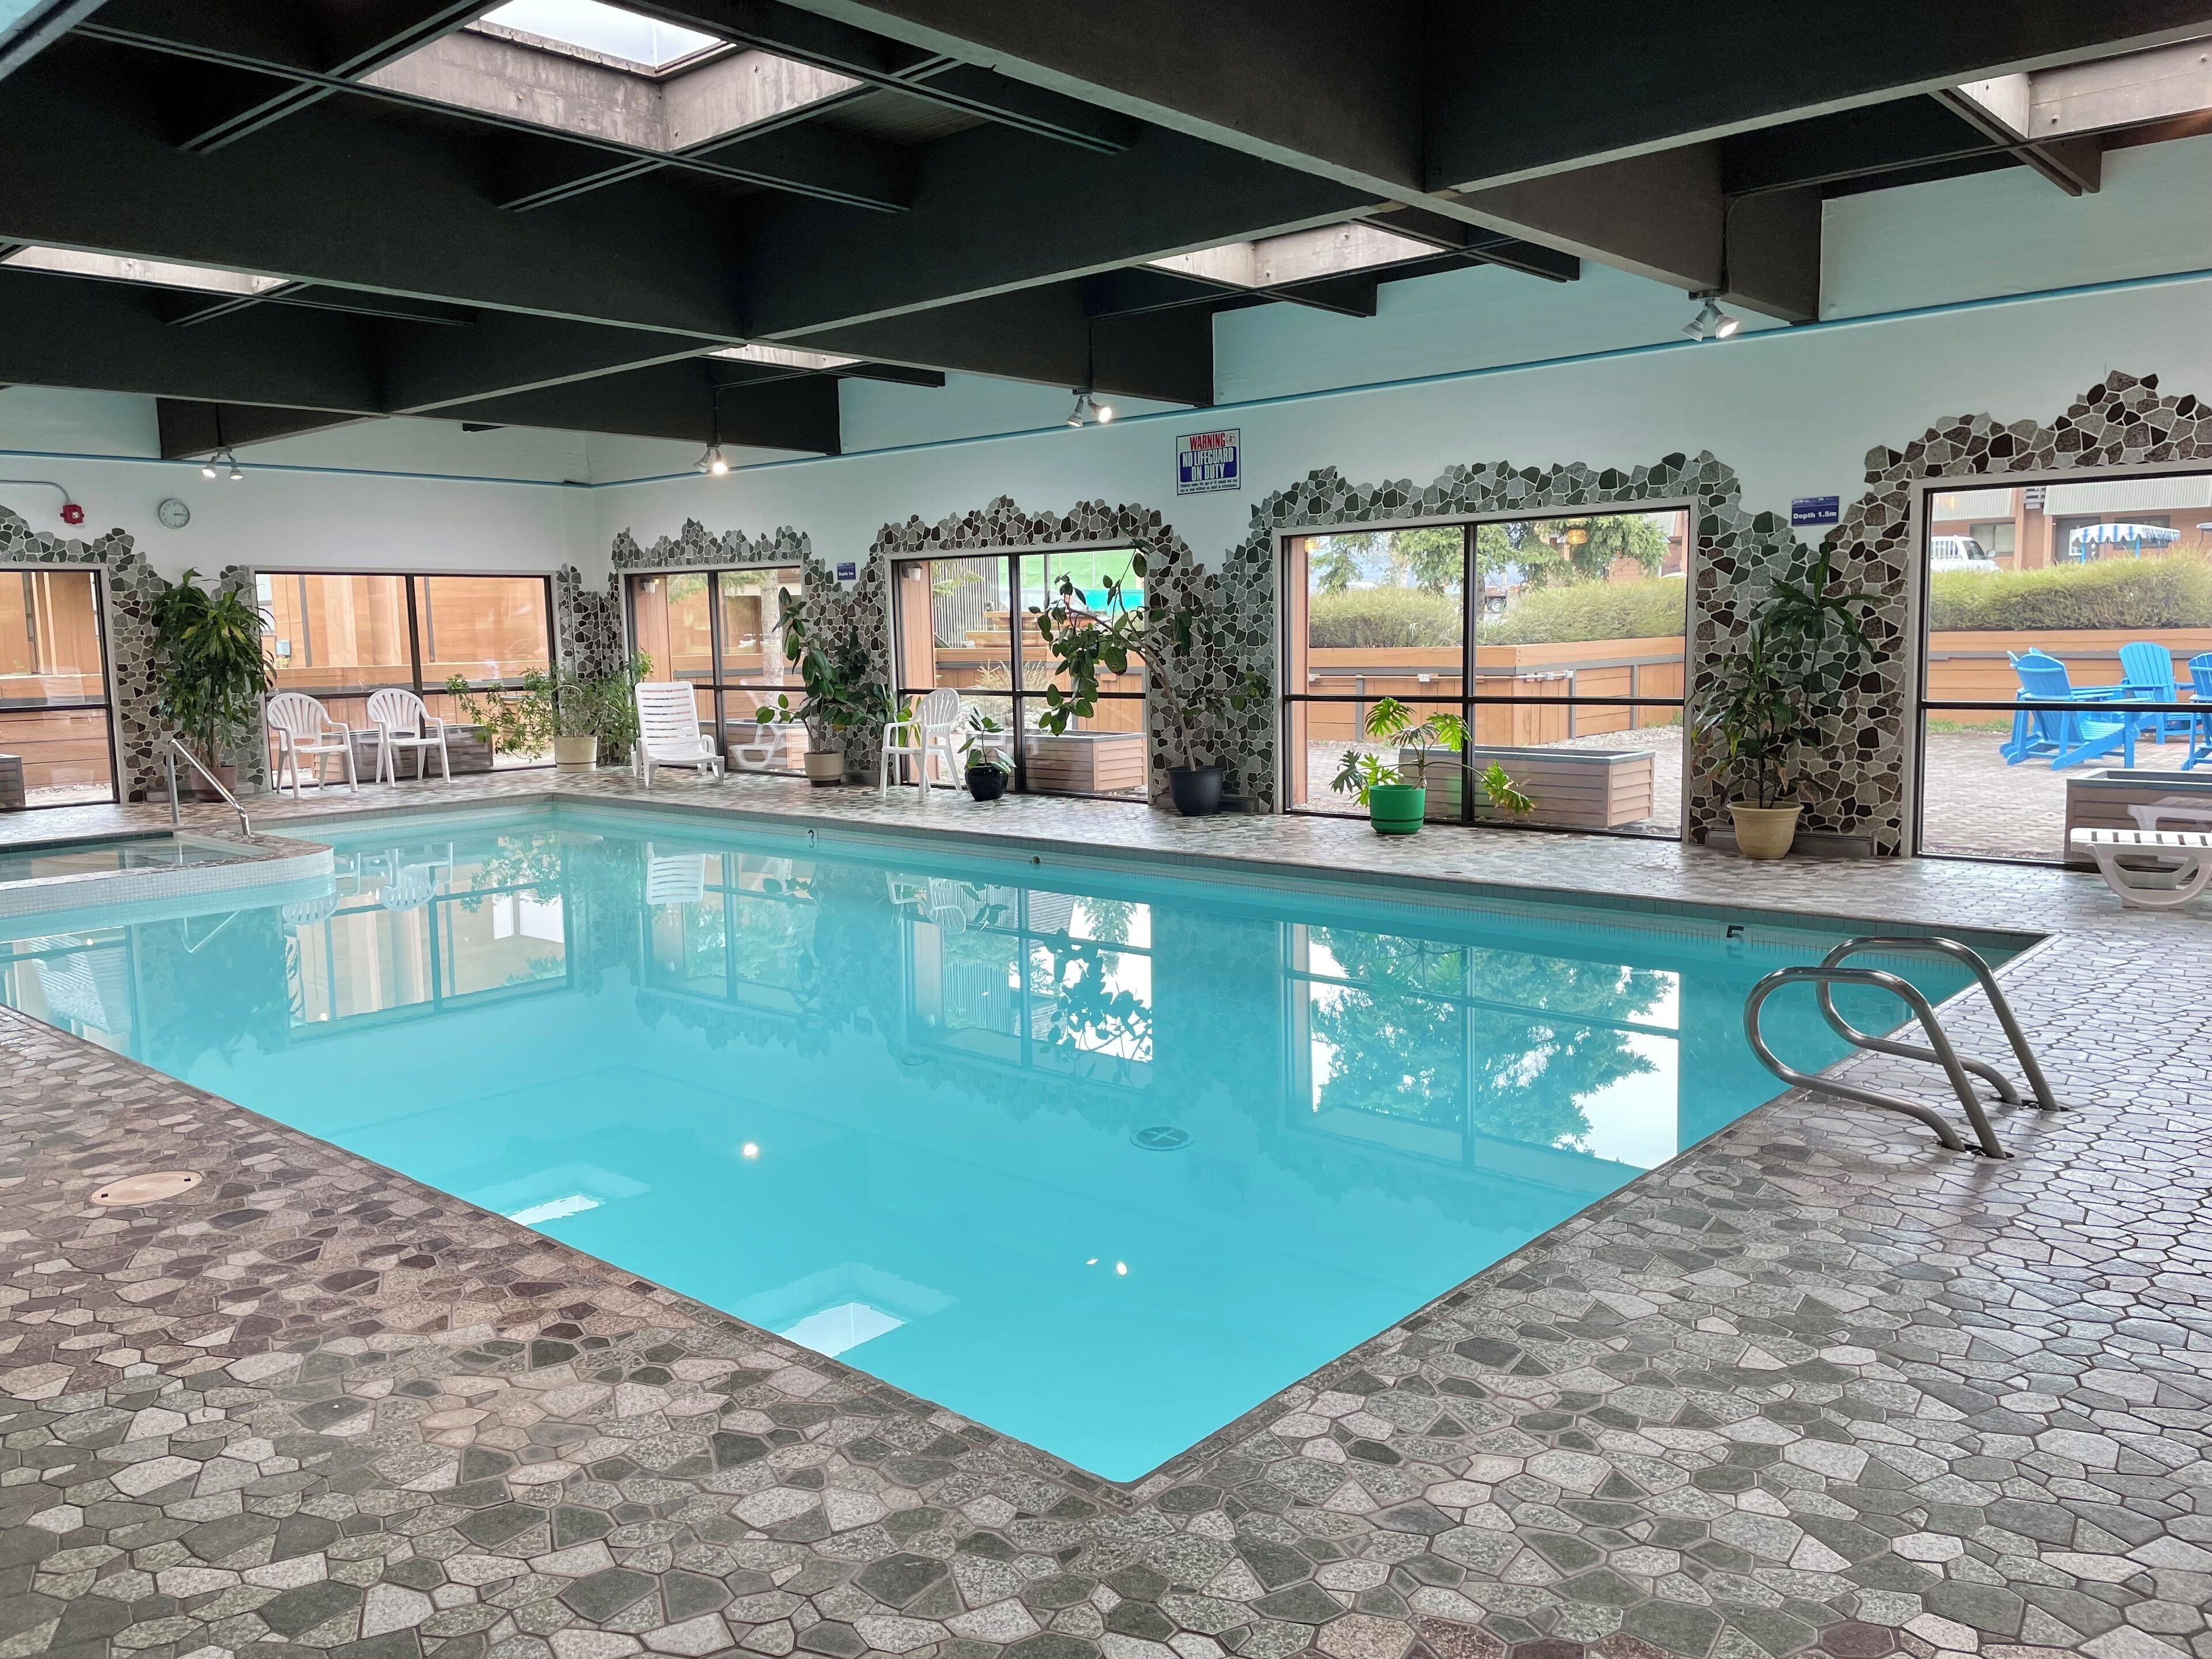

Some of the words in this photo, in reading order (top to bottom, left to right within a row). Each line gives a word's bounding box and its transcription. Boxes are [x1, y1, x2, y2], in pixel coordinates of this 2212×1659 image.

[1190, 433, 1225, 450] WARNING
[1183, 452, 1193, 467] NO
[1194, 447, 1234, 466] LIFEGUARD
[1191, 465, 1202, 481] ON
[1205, 463, 1225, 479] DUTY
[1726, 925, 1744, 944] 5
